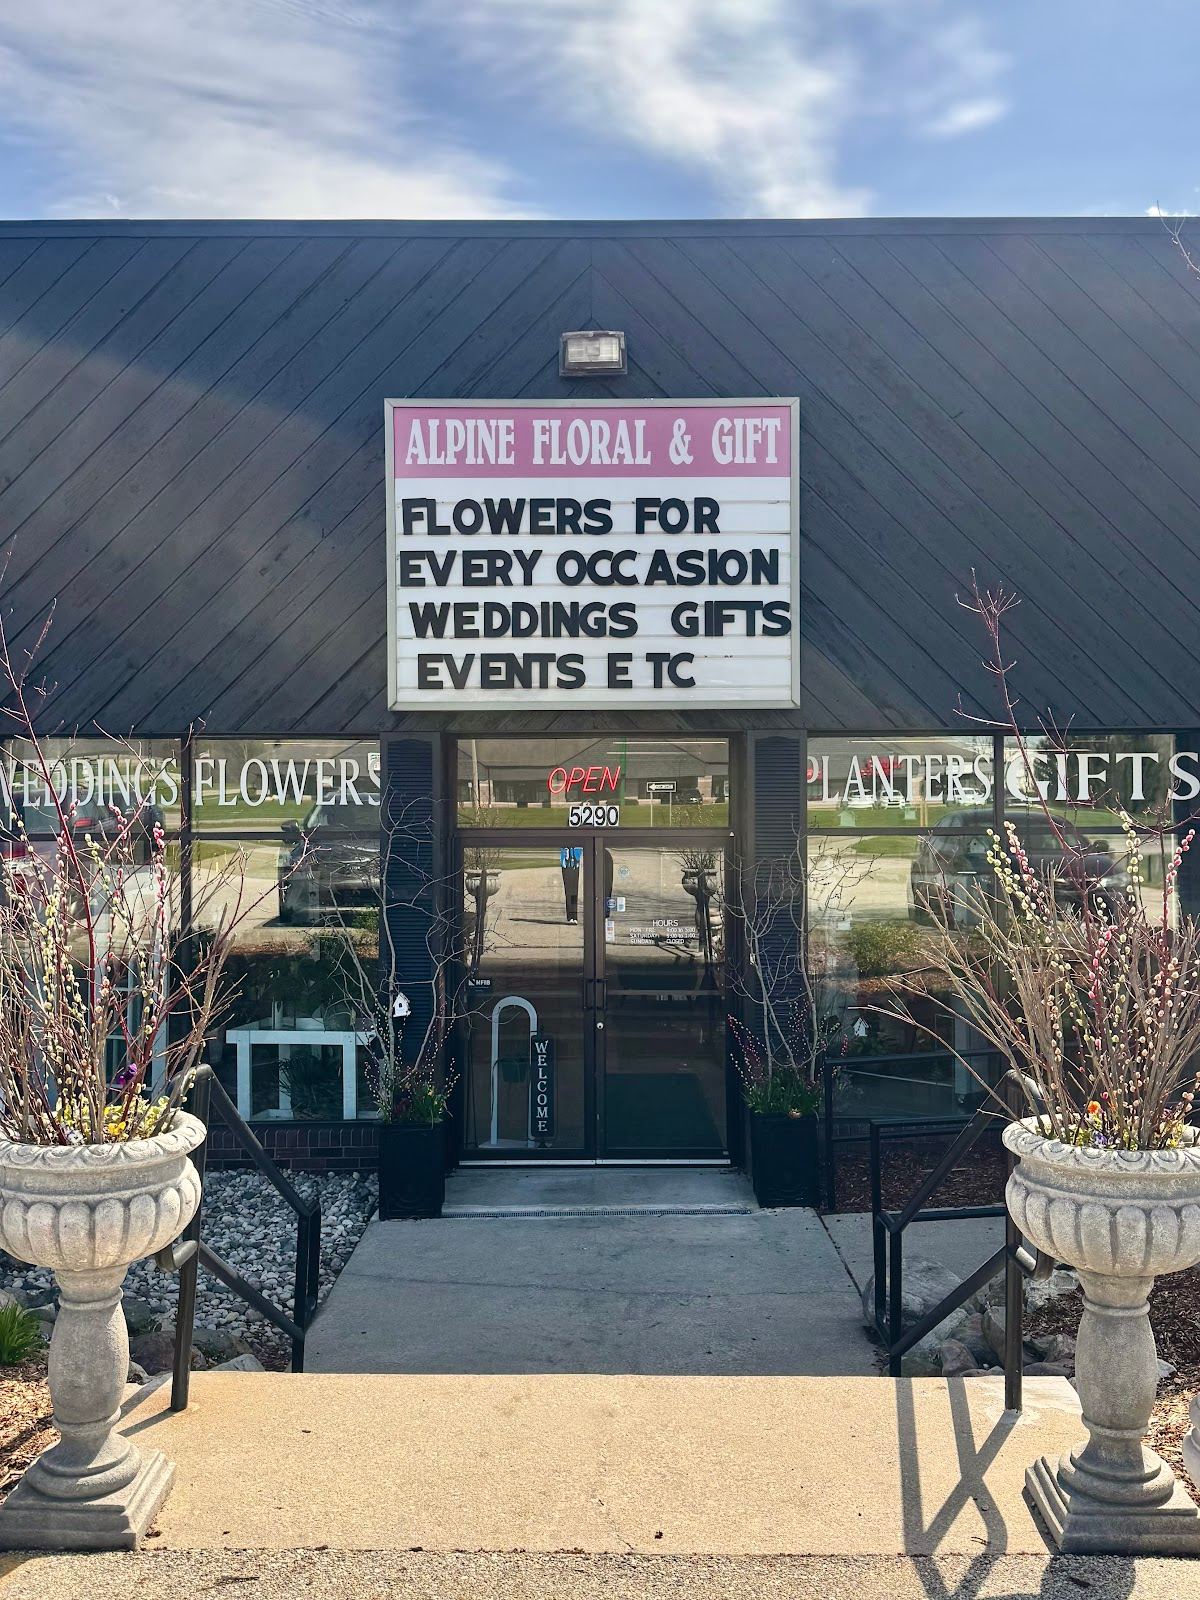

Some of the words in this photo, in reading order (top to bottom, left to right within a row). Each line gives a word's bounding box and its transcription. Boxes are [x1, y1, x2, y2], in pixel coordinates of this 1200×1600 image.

[405, 418, 515, 465] ALPINE
[532, 419, 651, 466] FLORAL
[669, 418, 693, 465] &
[712, 417, 781, 465] GIFT
[402, 498, 613, 535] FLOWERS
[635, 497, 721, 535] FOR
[400, 549, 543, 586] EVERY
[556, 548, 779, 586] OCCASION
[408, 601, 638, 638] WEDDINGS
[671, 601, 791, 637] GIFTS
[417, 653, 586, 690] EVENTS
[548, 766, 620, 793] OPEN
[1006, 751, 1200, 801] GIFTS
[570, 806, 618, 826] 5290
[534, 1040, 548, 1132] WELCOME
